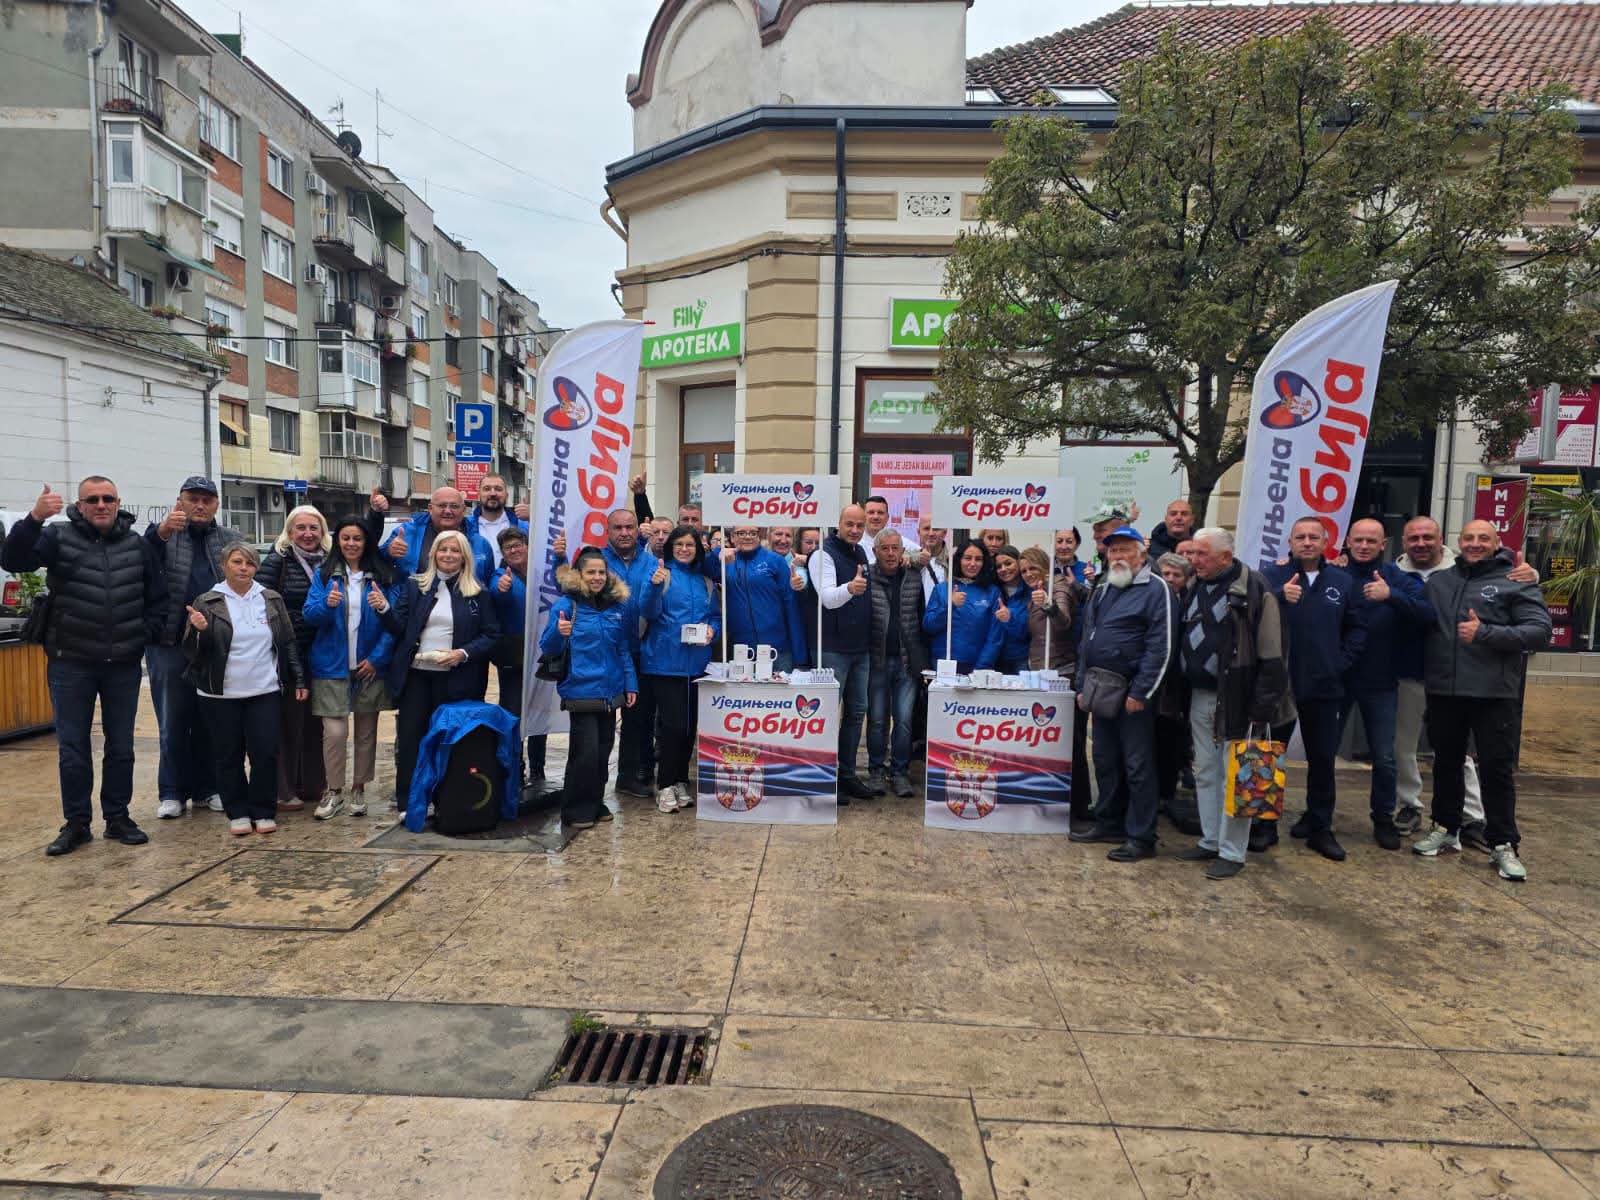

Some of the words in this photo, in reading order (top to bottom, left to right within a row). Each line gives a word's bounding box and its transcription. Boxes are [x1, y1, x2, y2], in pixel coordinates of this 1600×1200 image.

[673, 305, 704, 331] Filly
[900, 312, 962, 337] APO
[651, 329, 731, 361] APOTEKA
[464, 409, 484, 437] P
[457, 463, 480, 472] ZONA
[721, 482, 791, 495] Уједињена
[951, 484, 1023, 497] Уједињена
[732, 496, 818, 519] Србија
[961, 498, 1051, 521] Србија
[711, 695, 793, 710] Уједињена
[943, 701, 1029, 717] Уједињена
[723, 712, 826, 739] Србија
[956, 718, 1062, 747] Србија
